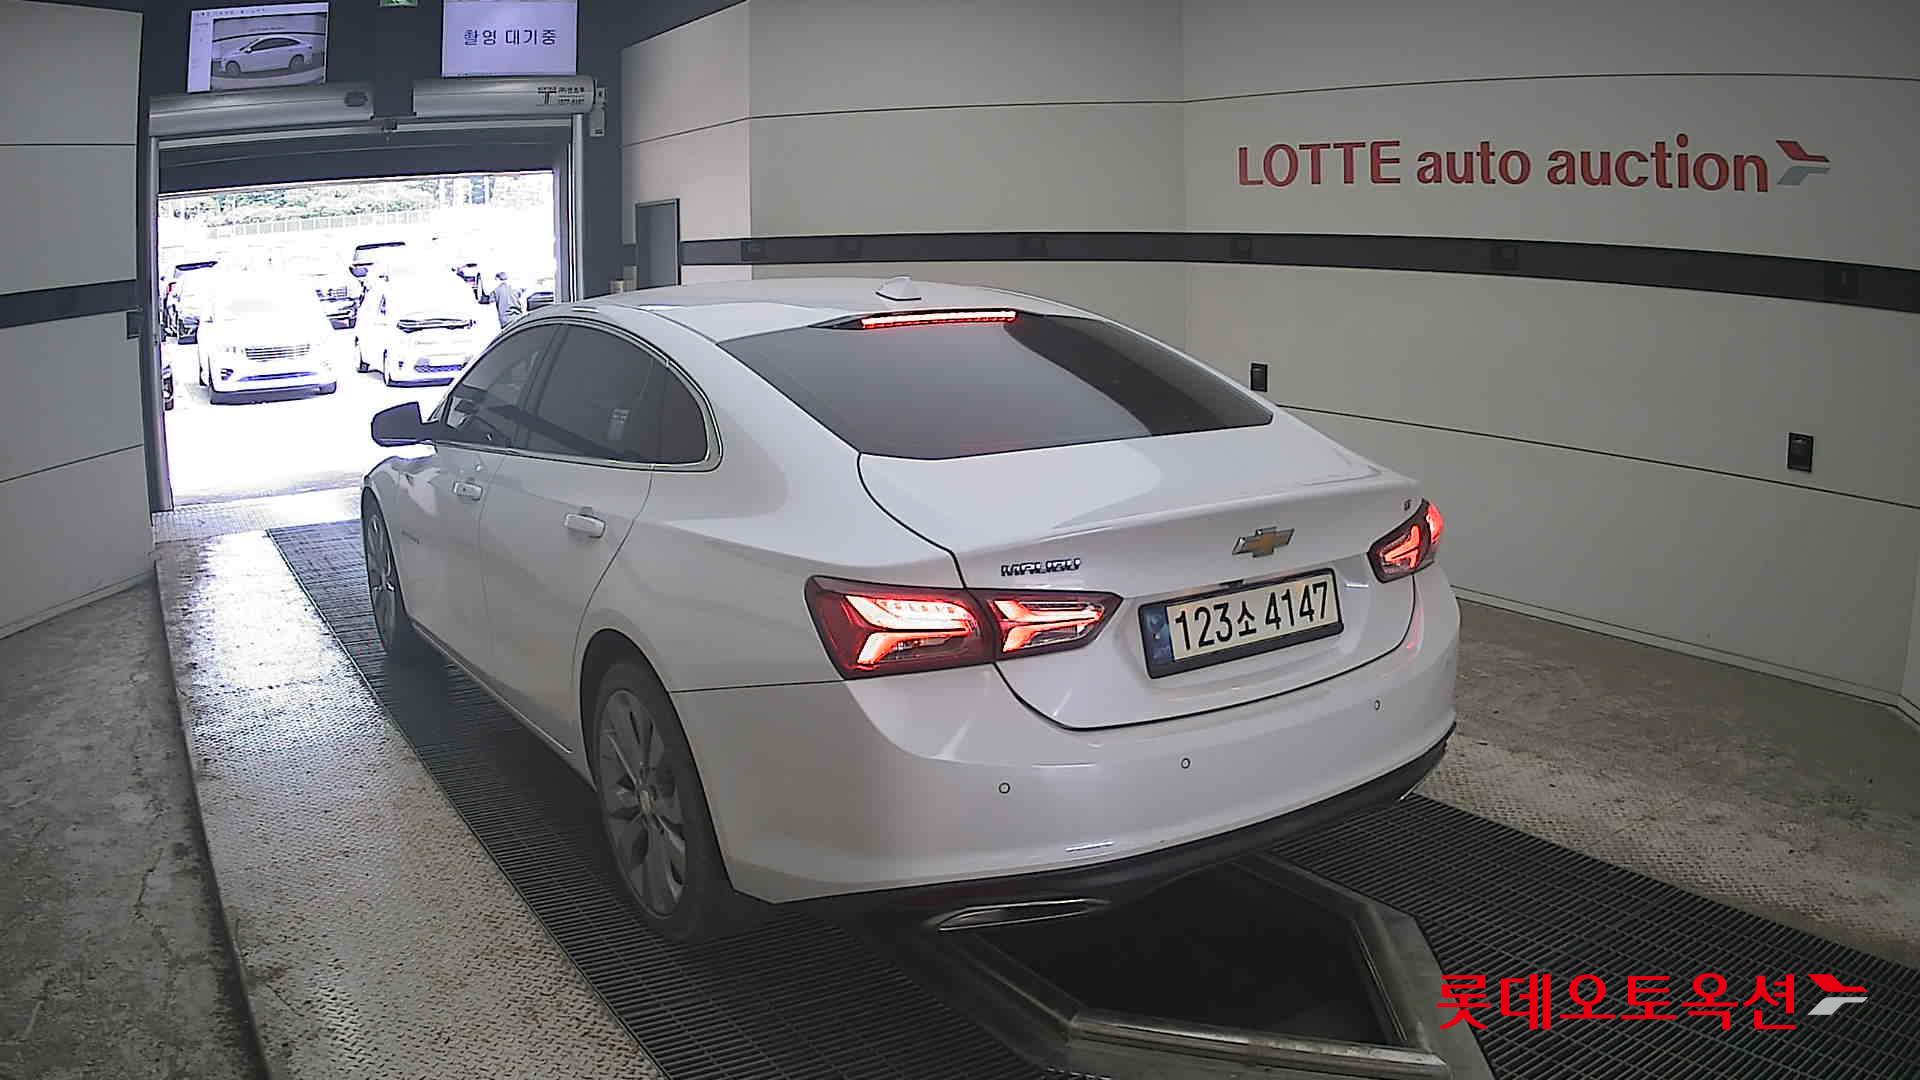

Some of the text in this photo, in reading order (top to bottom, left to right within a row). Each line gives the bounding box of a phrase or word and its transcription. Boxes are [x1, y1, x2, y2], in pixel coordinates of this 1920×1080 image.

[464, 29, 558, 46] 촬영 대기중
[1239, 133, 1769, 193] LOTTE auto auction
[1175, 581, 1328, 650] 123소 4147
